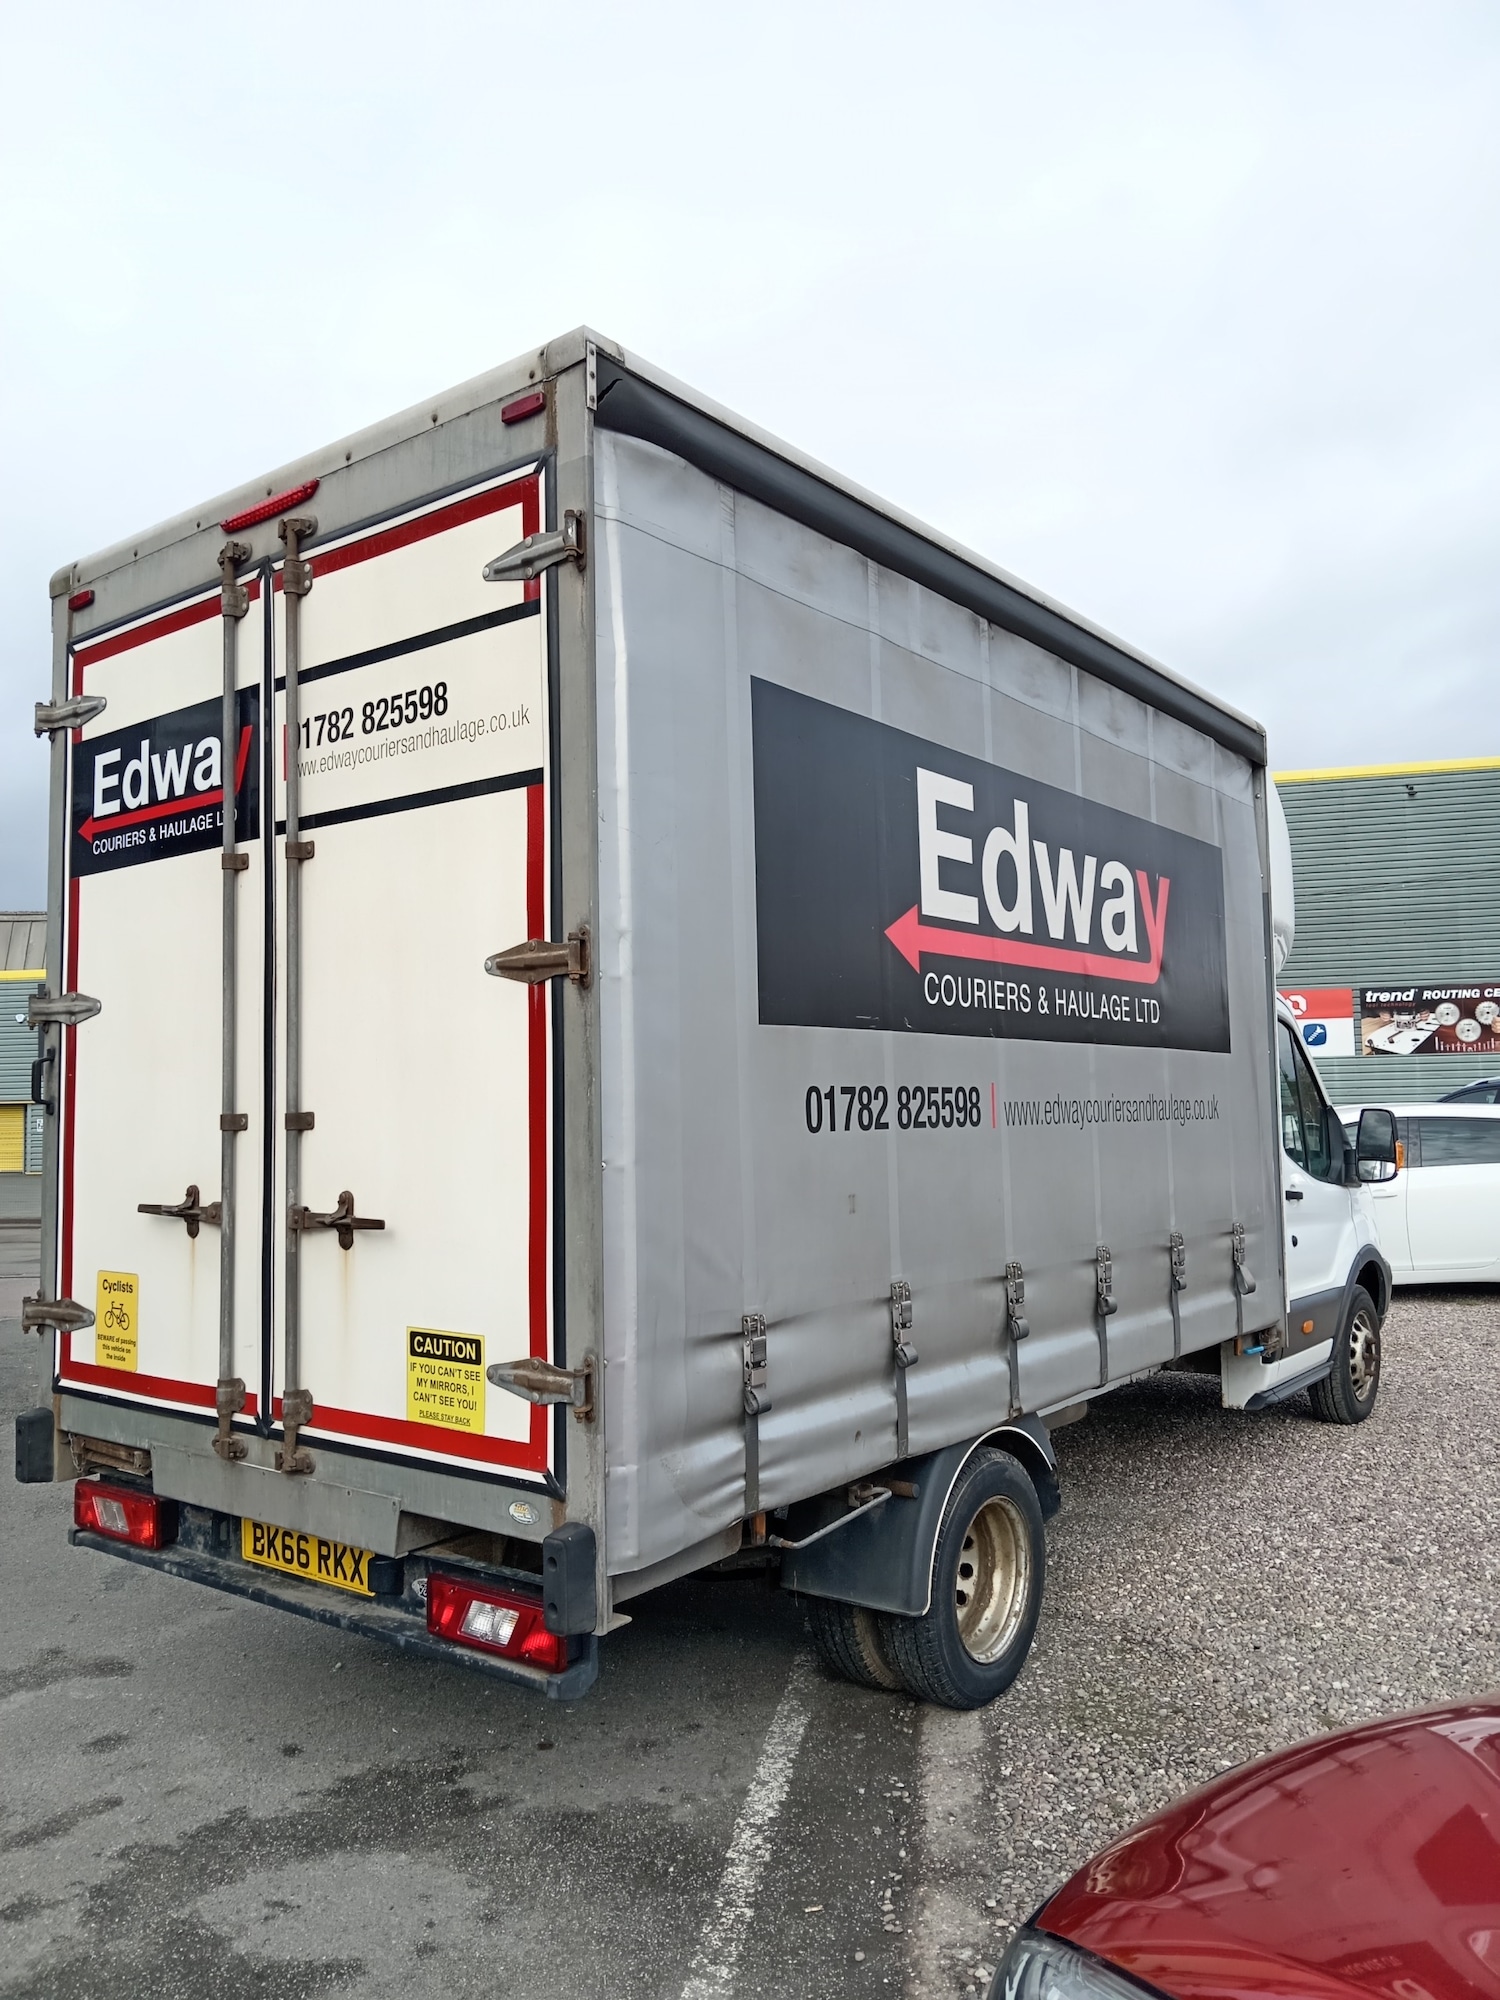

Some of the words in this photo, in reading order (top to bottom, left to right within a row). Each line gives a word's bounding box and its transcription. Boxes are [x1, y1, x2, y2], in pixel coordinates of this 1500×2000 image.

[362, 681, 447, 735] 825598
[297, 704, 531, 778] ww.edwaycouriersandhaulage.co.uk
[92, 829, 146, 855] COURIERS
[148, 826, 157, 842] &
[159, 814, 213, 839] HAULAGE
[916, 766, 1170, 985] Edway
[924, 972, 1031, 1014] COURIERS
[1037, 986, 1050, 1015] &
[1055, 989, 1131, 1023] HAULAGE
[1134, 998, 1161, 1024] LTD
[1365, 988, 1415, 1003] trend
[1422, 988, 1480, 1001] ROUTING
[805, 1085, 889, 1134] 01782
[898, 1086, 982, 1129] 825598
[1004, 1093, 1220, 1131] www.edwaycouriersandhaulage.co.uk
[102, 1279, 133, 1293] Cyclists
[413, 1335, 476, 1360] CAUTION
[409, 1362, 417, 1372] IF
[419, 1363, 436, 1375] YOU
[437, 1366, 462, 1379] CAN'T
[464, 1370, 481, 1382] SEE
[416, 1377, 429, 1388] MY
[429, 1379, 470, 1397] MIRRORS,
[471, 1385, 475, 1396] I
[412, 1391, 437, 1404] CAN'T
[438, 1395, 455, 1407] SEE
[456, 1398, 477, 1412] YOU!
[419, 1409, 440, 1420] PLEASE
[440, 1412, 455, 1423] STAY
[454, 1415, 471, 1426] BACK
[252, 1522, 310, 1570] BK66
[317, 1538, 364, 1586] RKX
